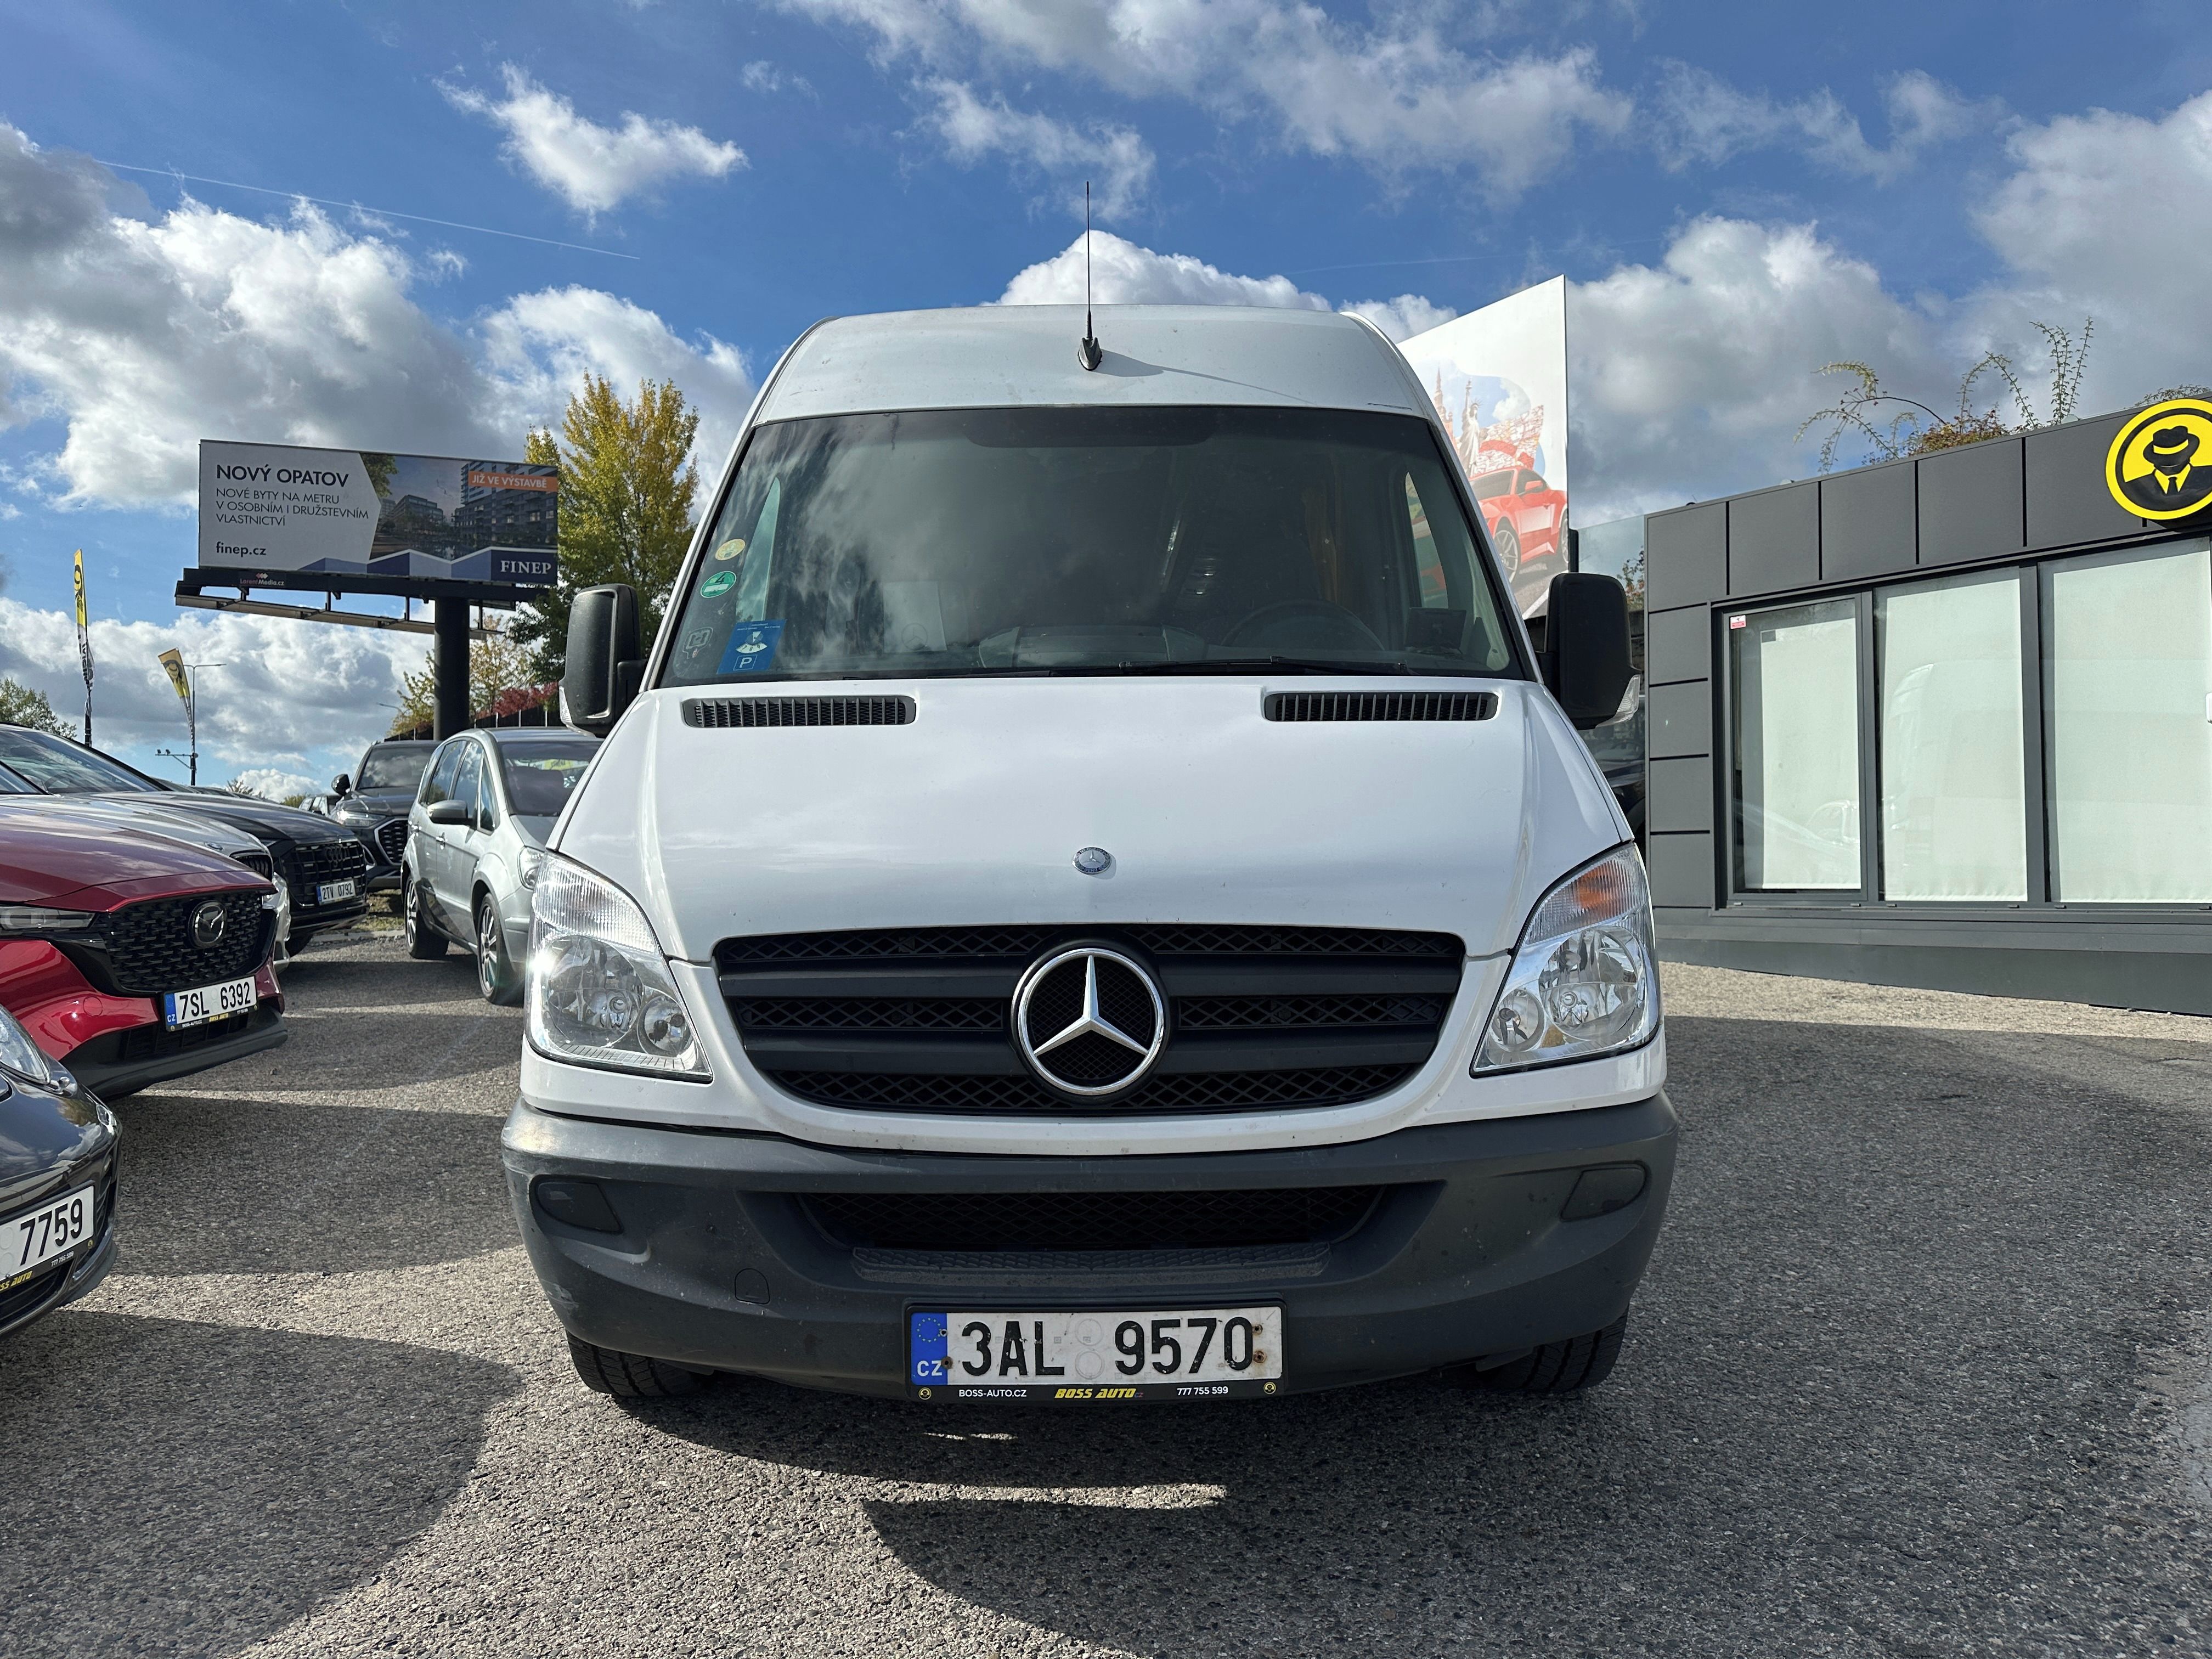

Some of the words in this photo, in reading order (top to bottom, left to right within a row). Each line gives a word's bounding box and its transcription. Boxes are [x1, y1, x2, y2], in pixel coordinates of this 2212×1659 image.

[217, 464, 271, 482] NOVÝ
[276, 469, 349, 487] OPATOV
[472, 473, 485, 483] JIŽ
[488, 476, 499, 485] VE
[501, 476, 547, 488] VÝSTAVBĚ
[216, 487, 250, 499] NOVÉ
[253, 490, 279, 500] BYTY
[283, 492, 300, 501] NA
[303, 494, 339, 504] METRU
[216, 501, 224, 510] V
[227, 501, 283, 514] OSOBNÍM
[286, 505, 289, 514] I
[293, 505, 369, 519] DRUŽSTEVNÍM
[216, 514, 286, 526] VLASTNICTVÍ
[216, 541, 267, 557] finep.cz
[500, 560, 552, 574] FINEP
[714, 573, 726, 584] 4
[739, 657, 752, 668] P
[322, 886, 334, 900] 2TV
[338, 883, 353, 896] 0792
[179, 991, 210, 1020] 7SL
[220, 981, 251, 1009] 6392
[167, 1014, 176, 1023] CZ
[20, 1198, 82, 1266] 7759
[10, 1270, 33, 1286] AUTO
[961, 1320, 1065, 1377] 3AL
[1114, 1317, 1254, 1376] 9570
[917, 1360, 943, 1377] CZ
[958, 1389, 1027, 1398] BOSS-AUTO.CZ
[1054, 1388, 1093, 1398] BOSS
[1095, 1388, 1136, 1398] AUTO
[1177, 1387, 1192, 1396] 777
[1193, 1387, 1210, 1395] 755
[1211, 1386, 1228, 1395] 599
